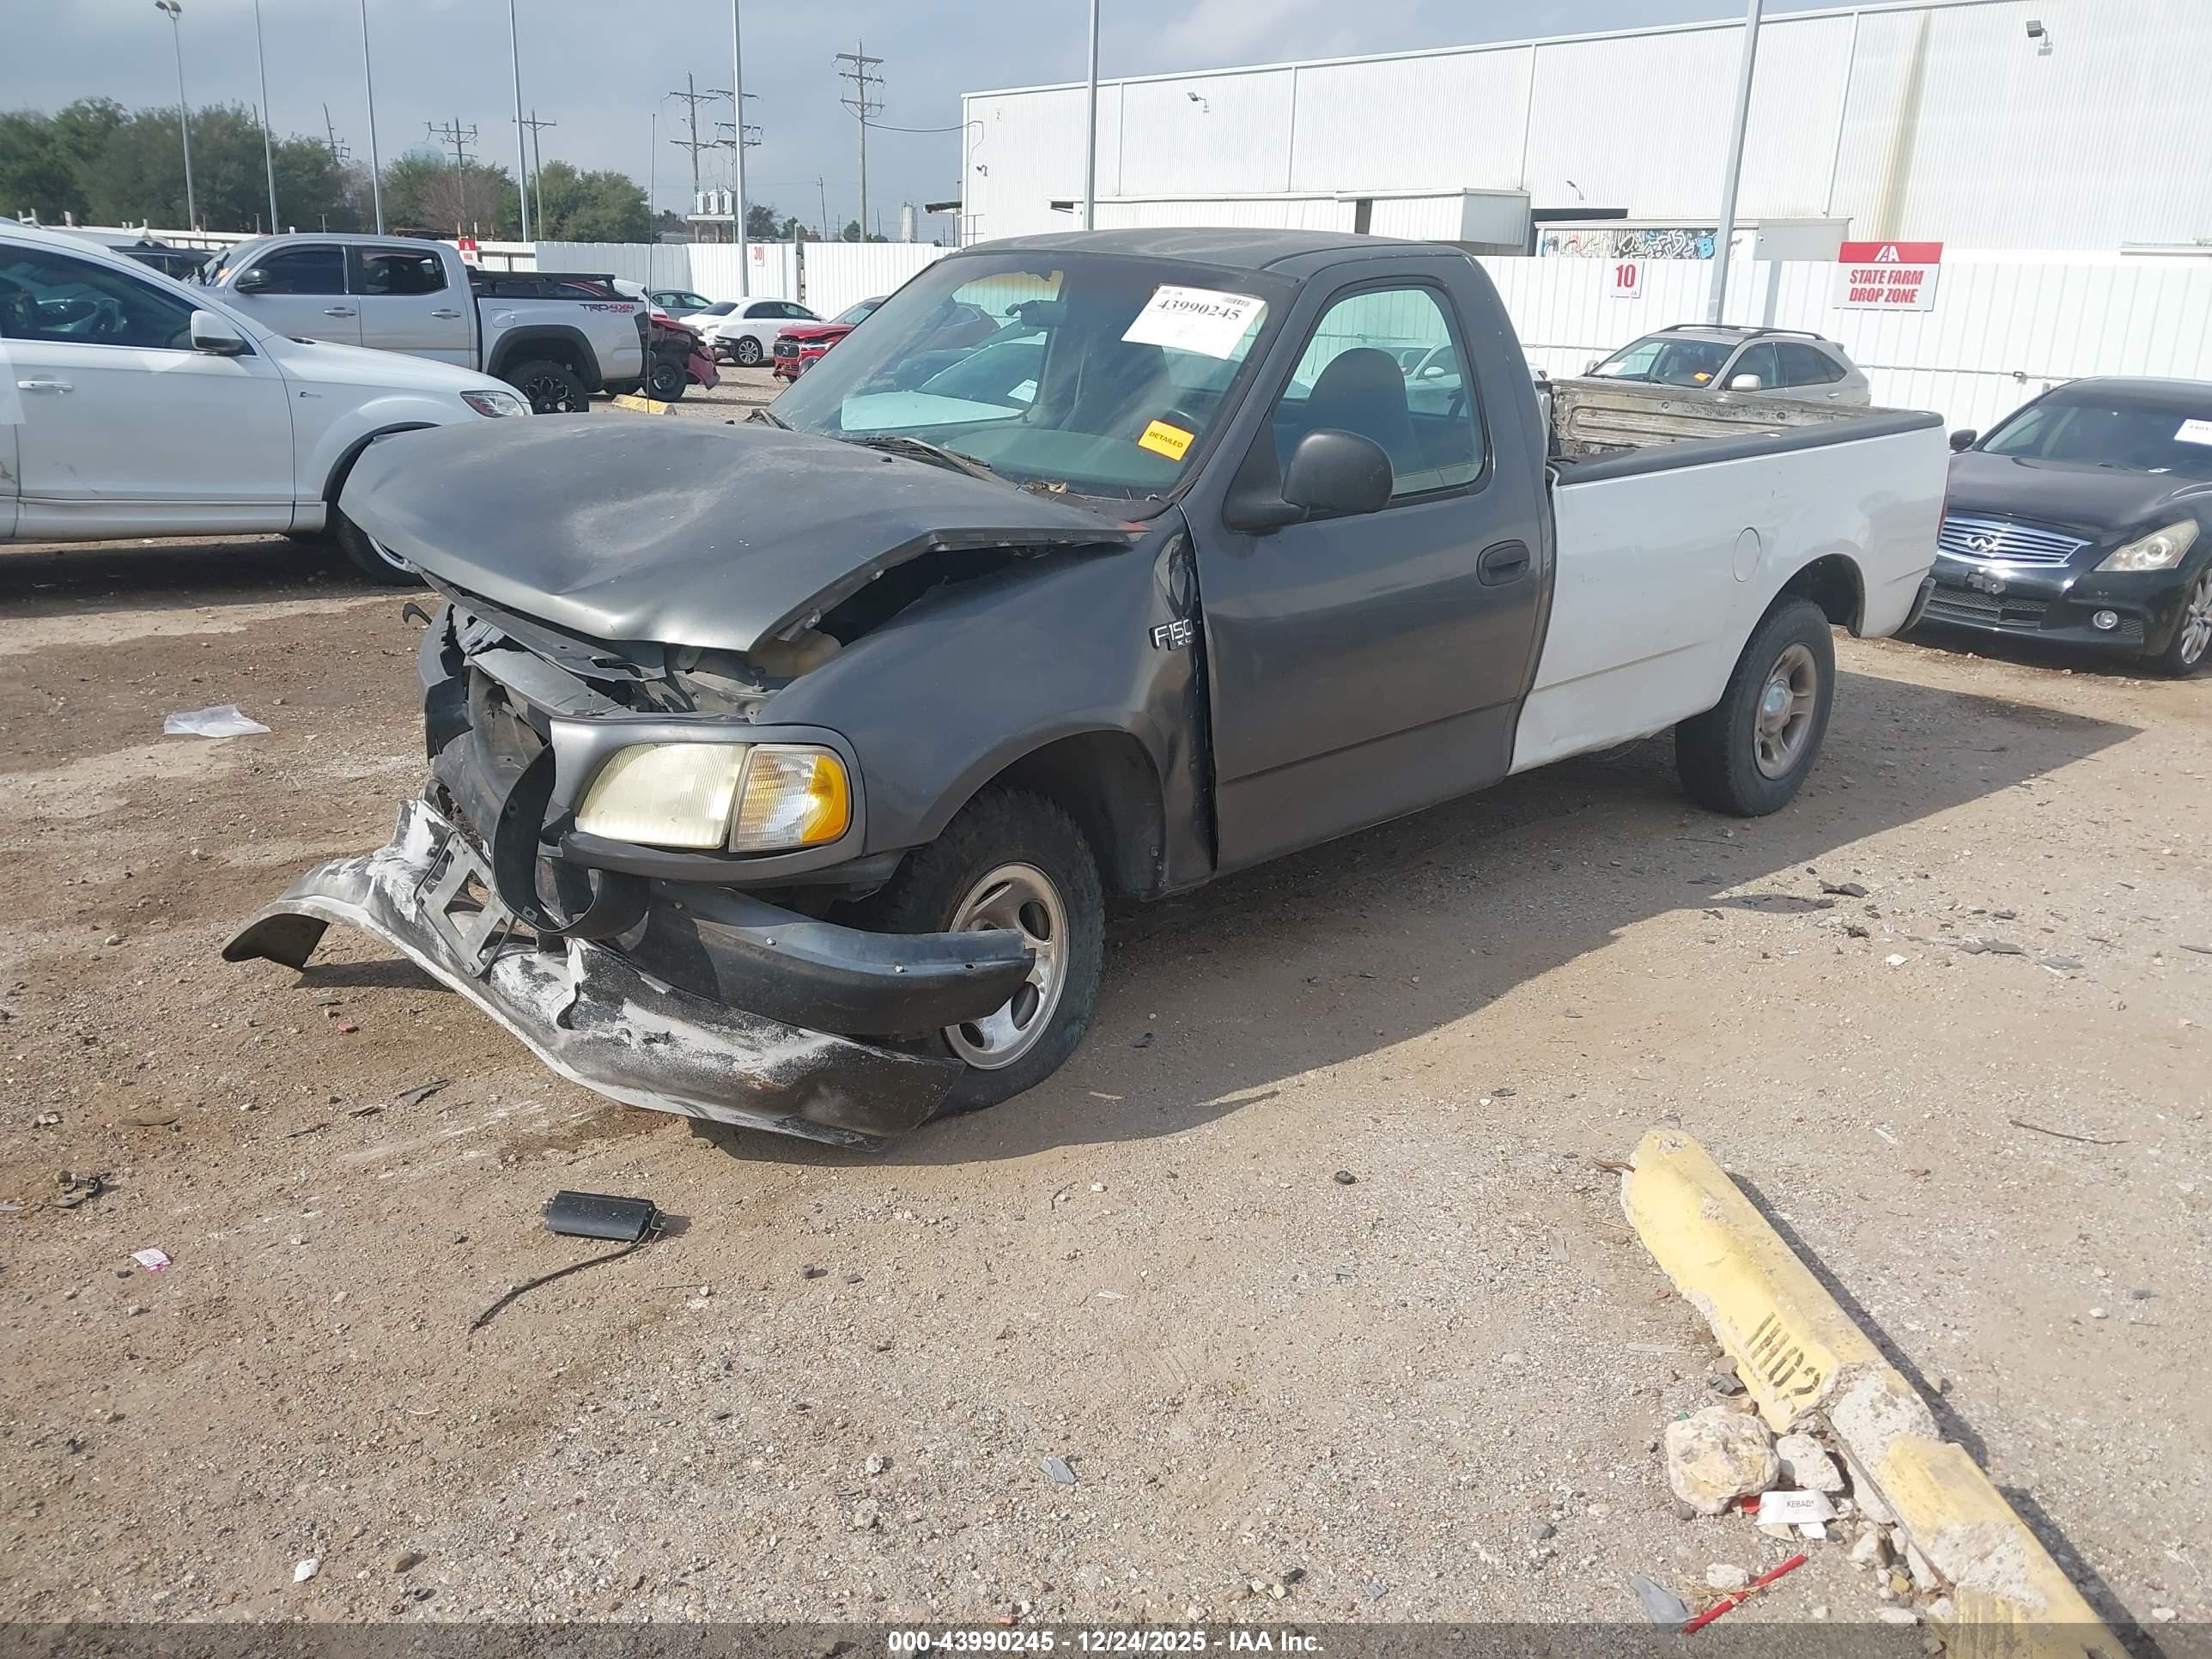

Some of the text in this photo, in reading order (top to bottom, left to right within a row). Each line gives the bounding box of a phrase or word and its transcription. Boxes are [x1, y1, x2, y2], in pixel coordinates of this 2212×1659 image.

[754, 246, 763, 260] 30
[1615, 264, 1636, 288] 10
[1849, 269, 1924, 285] STATE FARM
[1849, 287, 1918, 303] DROP ZONE
[1158, 299, 1243, 321] 43990245
[1148, 431, 1183, 448] DETAILED
[1154, 618, 1194, 647] F150
